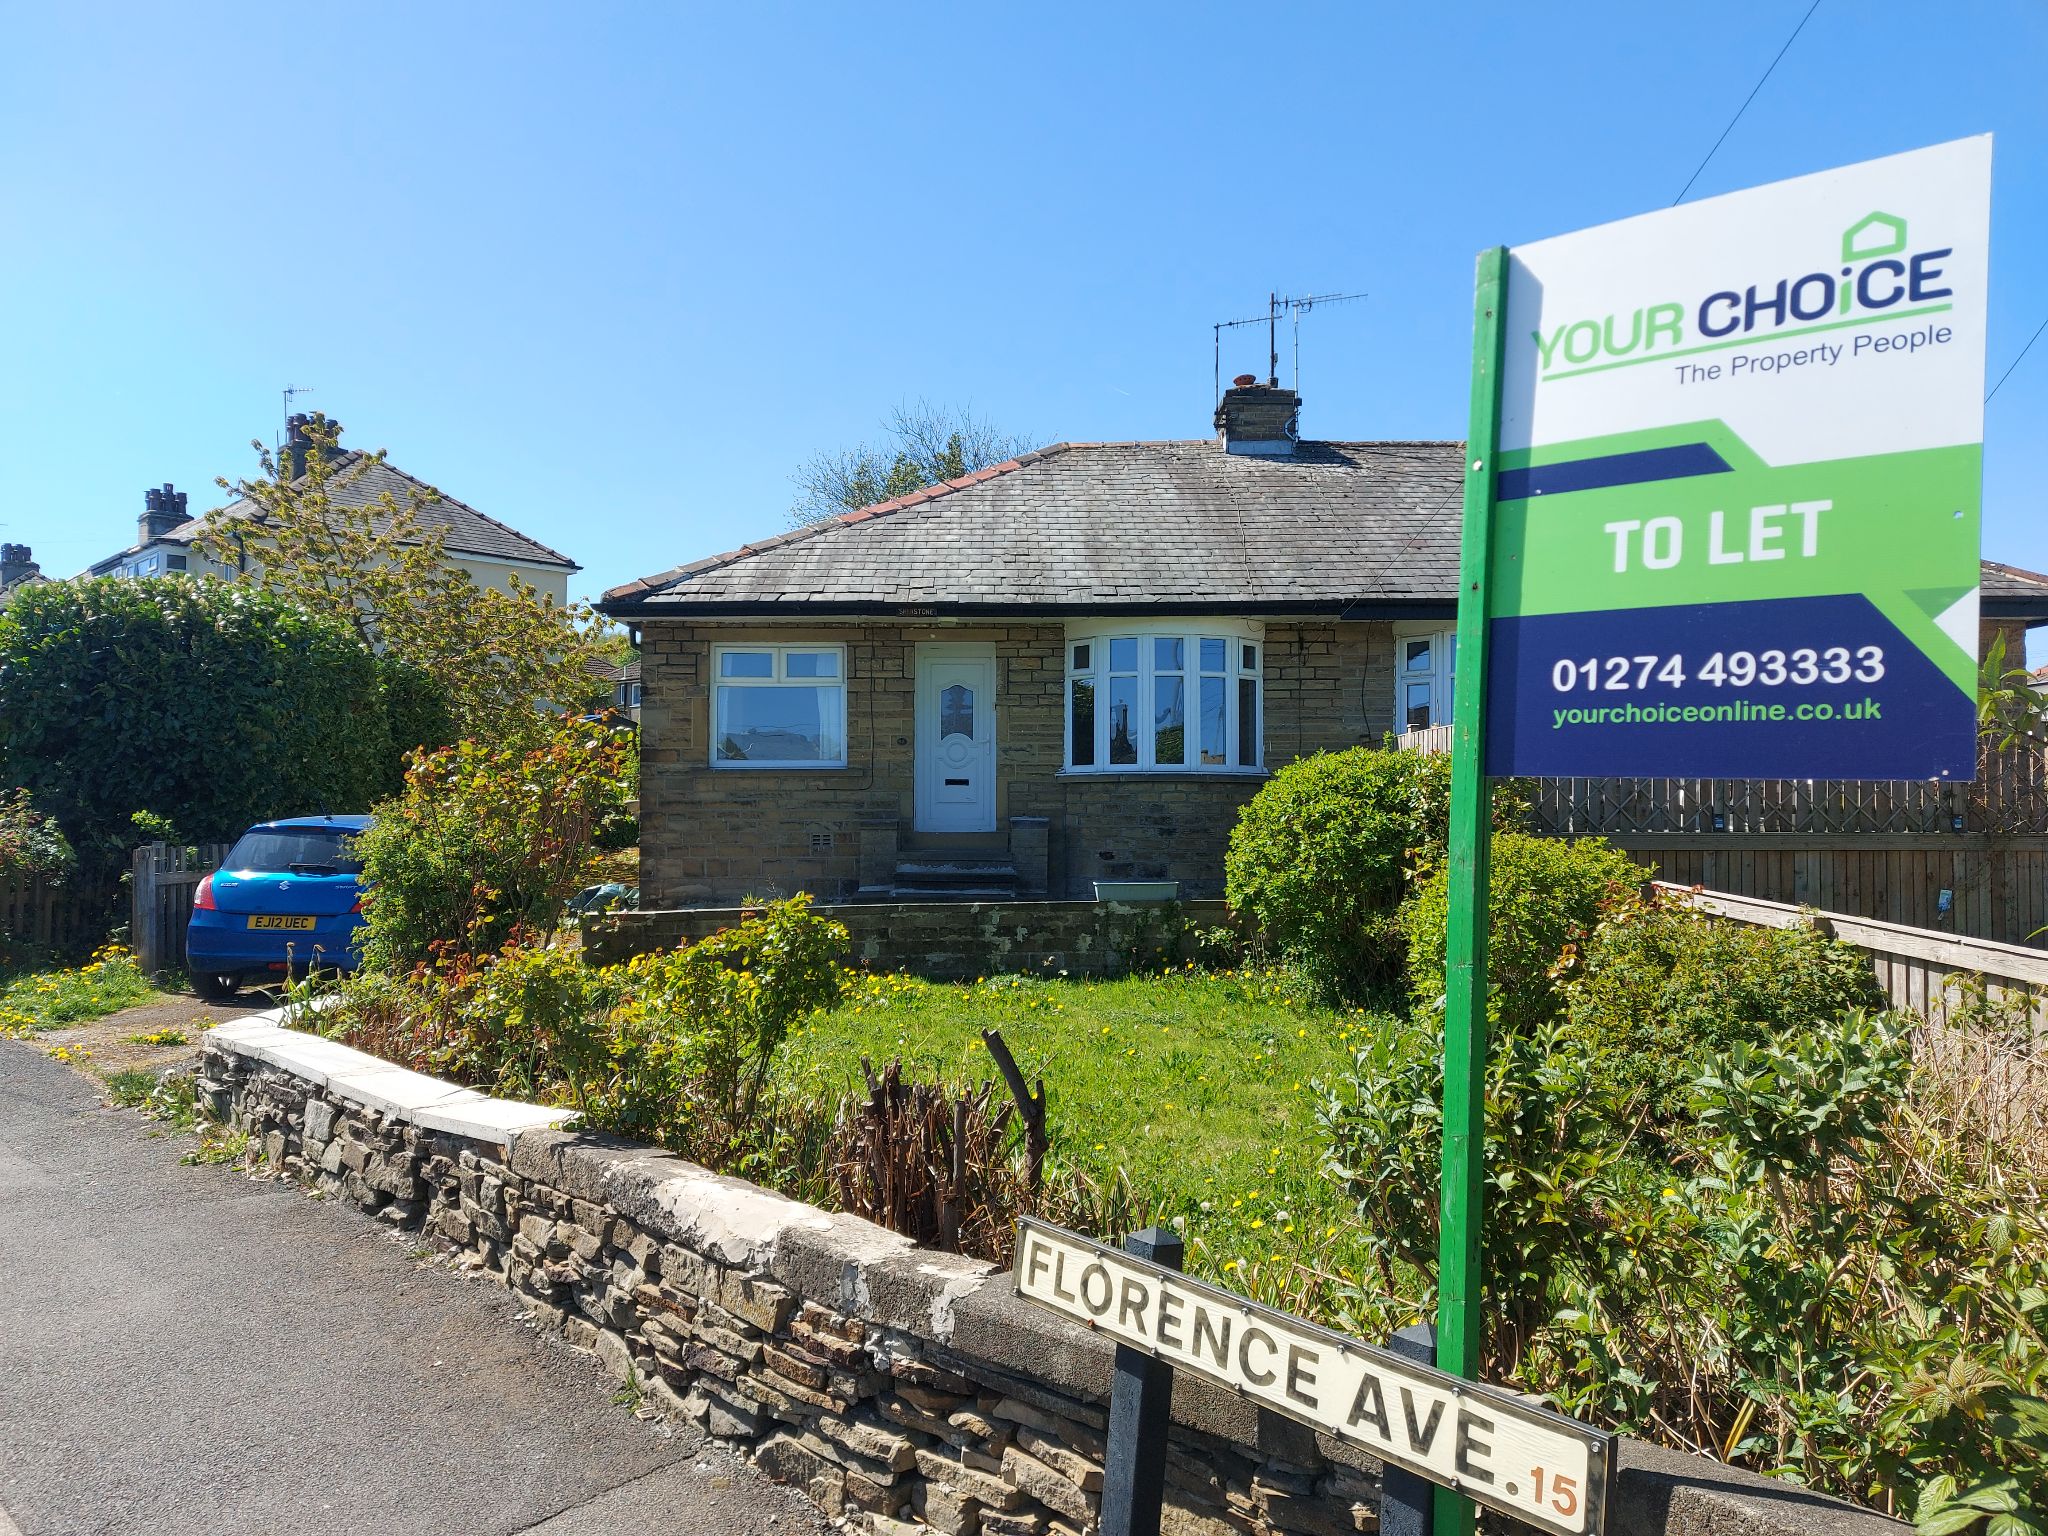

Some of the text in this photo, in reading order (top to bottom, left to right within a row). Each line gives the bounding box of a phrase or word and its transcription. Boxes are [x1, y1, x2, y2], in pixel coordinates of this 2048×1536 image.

[1531, 302, 1685, 371] YOUR
[1675, 324, 1953, 386] The Property People
[1604, 499, 1833, 574] TO LET
[1552, 645, 1886, 693] 01274 493333
[1552, 698, 1882, 729] yourchoiceonline.co.uk
[255, 916, 309, 929] EJ12 UEC
[1026, 1238, 1320, 1411] FLORENCE
[1530, 1465, 1579, 1518] 15
